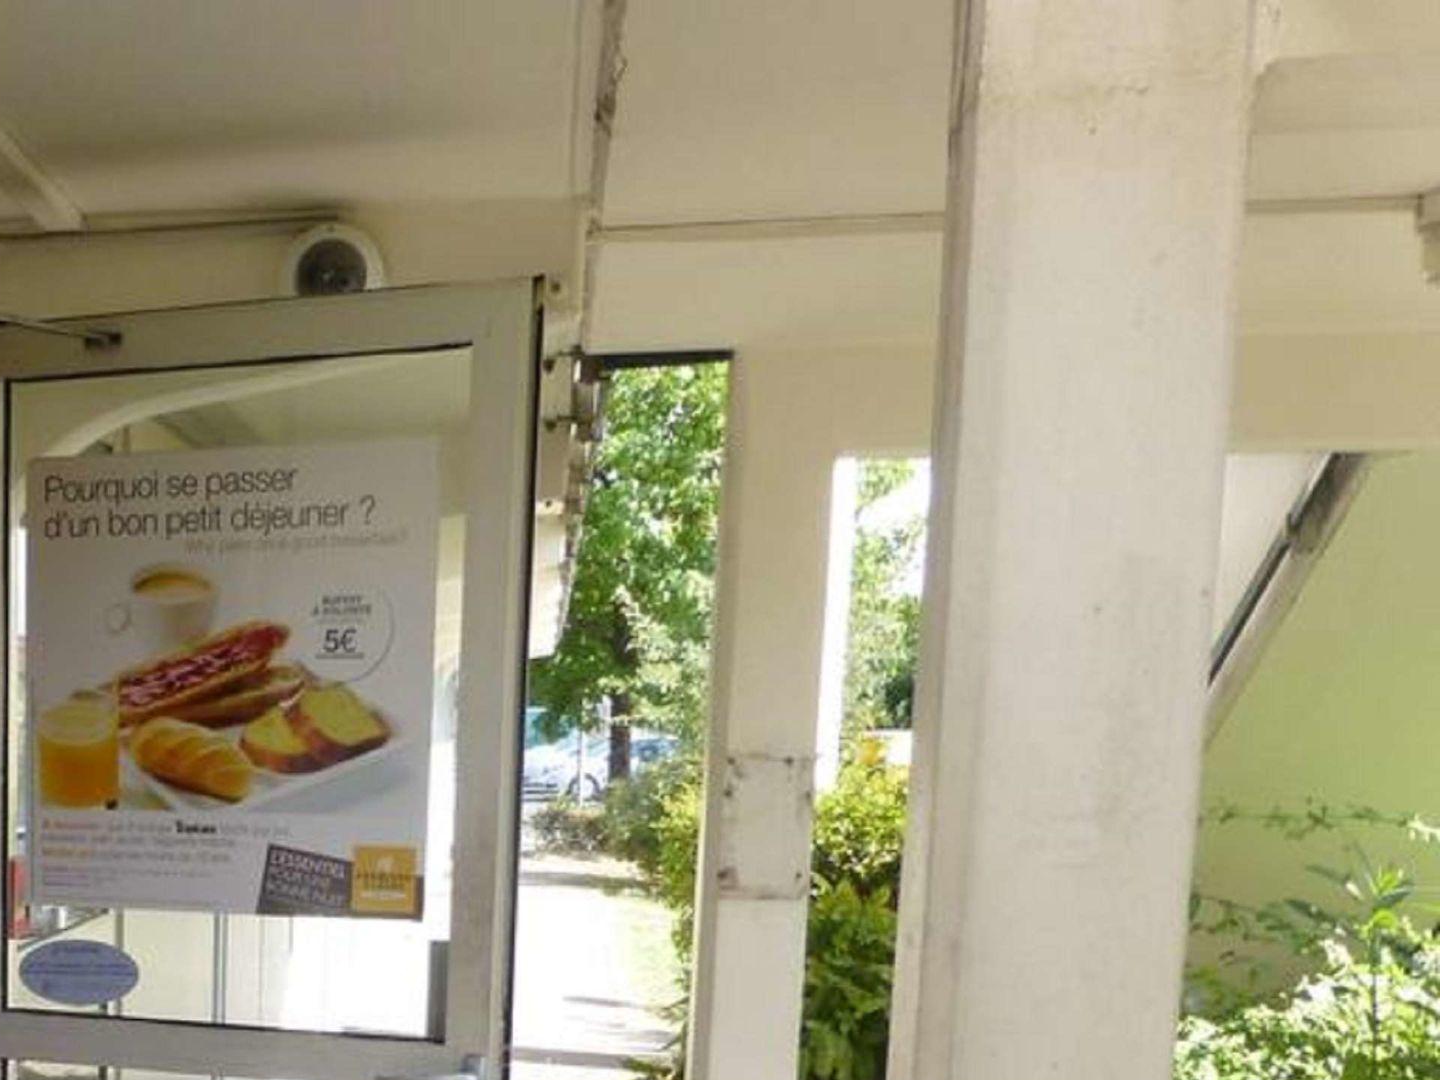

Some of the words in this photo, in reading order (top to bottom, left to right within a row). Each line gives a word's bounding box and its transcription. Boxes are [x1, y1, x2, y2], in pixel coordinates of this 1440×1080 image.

[44, 473, 158, 505] Pourquoi
[166, 478, 198, 498] se
[206, 468, 297, 504] passer
[44, 511, 99, 540] d'un
[109, 509, 158, 537] bon
[165, 504, 221, 540] petit
[230, 498, 346, 536] déjeuner
[359, 495, 375, 525] ?
[324, 629, 357, 653] 5€
